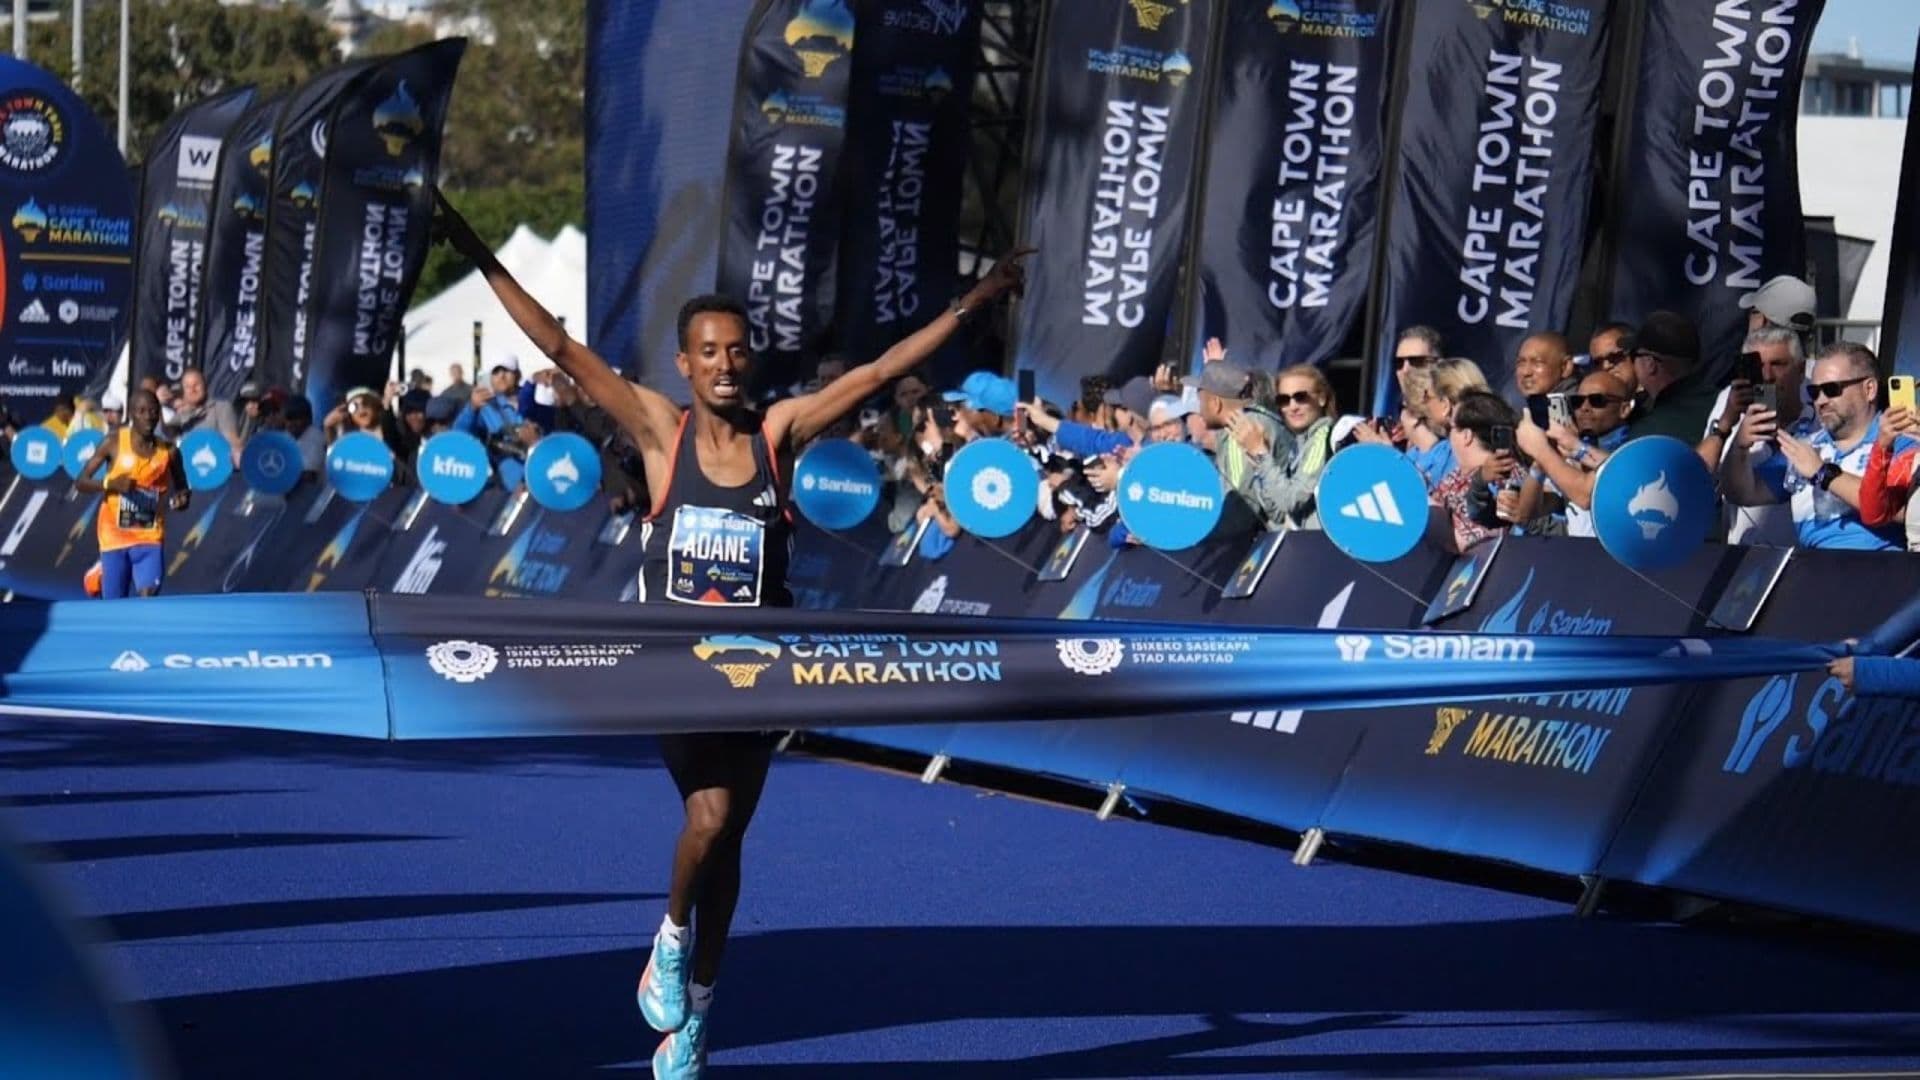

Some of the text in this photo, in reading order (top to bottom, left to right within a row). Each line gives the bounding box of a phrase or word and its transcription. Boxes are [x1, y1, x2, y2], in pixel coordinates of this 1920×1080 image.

[1503, 8, 1589, 36] MARATHON
[1548, 2, 1591, 21] TOWN
[1301, 23, 1376, 37] MARATHON
[189, 148, 212, 167] W
[1725, 0, 1799, 289] MARATHON
[1268, 59, 1321, 309] CAPE TOWN
[1300, 63, 1358, 308] MARATHON
[1458, 48, 1523, 325] CAPE TOWN
[1494, 55, 1563, 329] MARATHON
[49, 217, 130, 233] CAPE TOWN
[1684, 147, 1723, 286] CAPE
[48, 229, 129, 245] MARATHON
[748, 144, 796, 350] CAPE TOWN
[774, 145, 823, 350] MARATHON
[237, 232, 264, 305] TOWN
[166, 240, 190, 381] CAPE TOWN
[230, 311, 253, 372] CAPE
[818, 476, 873, 496] Sanlam
[1147, 486, 1213, 511] Sanlam
[682, 531, 751, 563] ADANE
[1549, 609, 1614, 635] Sanlam
[564, 648, 635, 657] SASEKAPA
[789, 640, 999, 658] CAPE TOWN
[1131, 641, 1250, 651] ISIXEKO SASEKAPA
[1132, 653, 1234, 664] STAD KAAPSTAD
[1382, 634, 1536, 662] Sanlam
[508, 656, 619, 668] STAD KAAPSTAD
[792, 660, 1003, 685] MARATHON
[1463, 711, 1612, 774] MARATHON
